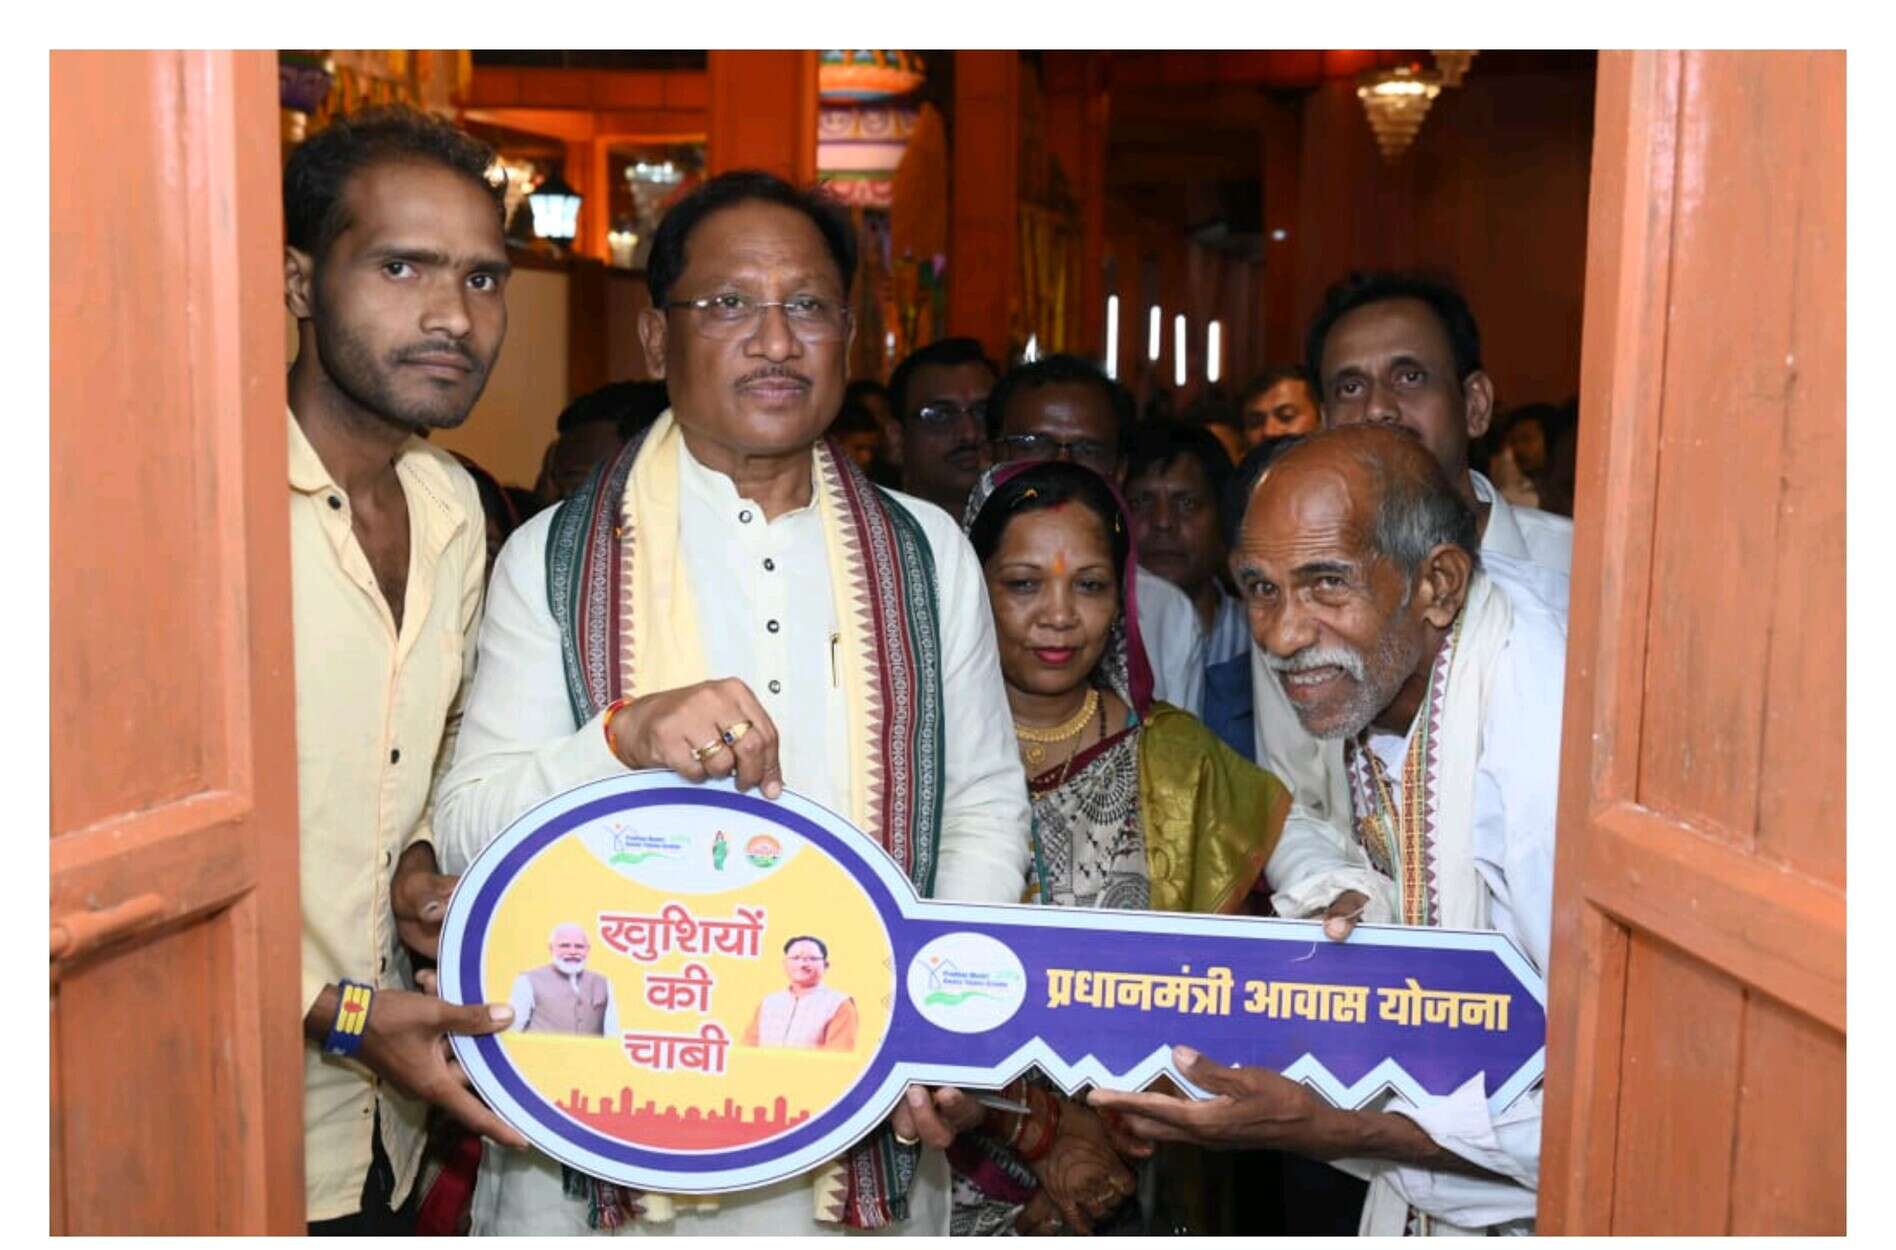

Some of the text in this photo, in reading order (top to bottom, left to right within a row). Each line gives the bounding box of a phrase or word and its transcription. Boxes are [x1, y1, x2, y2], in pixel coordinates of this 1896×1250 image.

[600, 904, 765, 961] खुशियों
[646, 963, 713, 1012] की
[1046, 964, 1235, 1016] प्रधानमंत्री
[1243, 979, 1371, 1024] आवास
[1376, 977, 1512, 1031] योजना
[624, 1023, 730, 1072] चाबी
